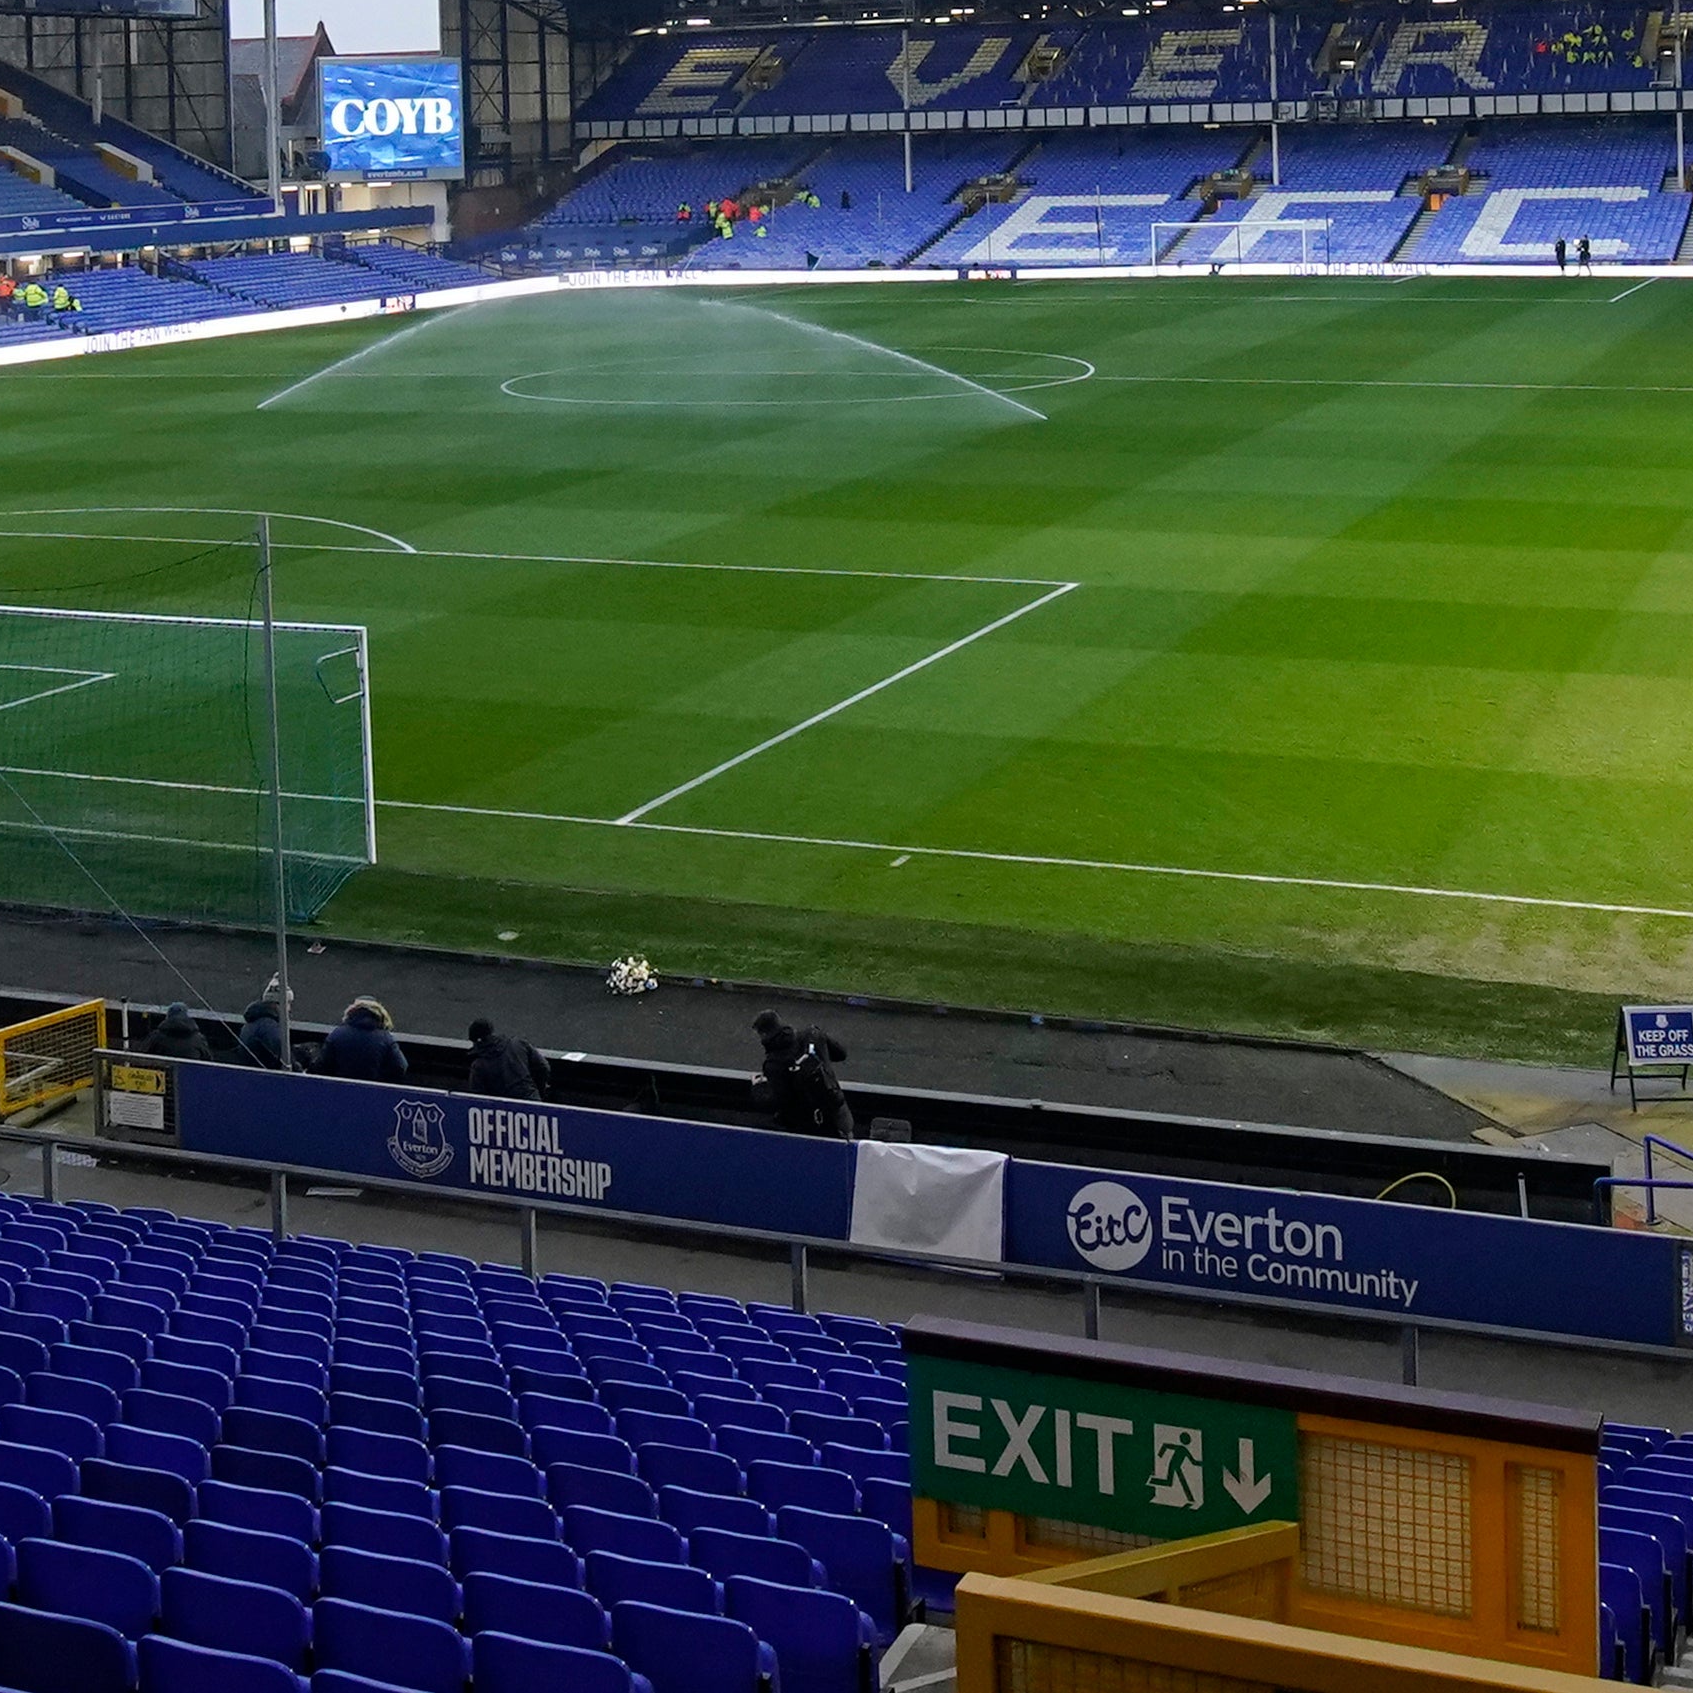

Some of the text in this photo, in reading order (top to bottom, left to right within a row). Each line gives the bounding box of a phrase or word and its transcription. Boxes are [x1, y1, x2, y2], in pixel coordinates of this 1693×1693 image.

[331, 97, 454, 136] COYB
[1635, 1044, 1658, 1057] THE
[1638, 1029, 1690, 1042] KEEP OFF
[402, 1140, 439, 1156] Everton
[468, 1106, 564, 1156] OFFICIAL
[469, 1145, 613, 1201] MEMBERSHIP
[1160, 1195, 1344, 1261] Everton
[1161, 1242, 1420, 1308] in the Community
[932, 1388, 1133, 1497] EXIT
